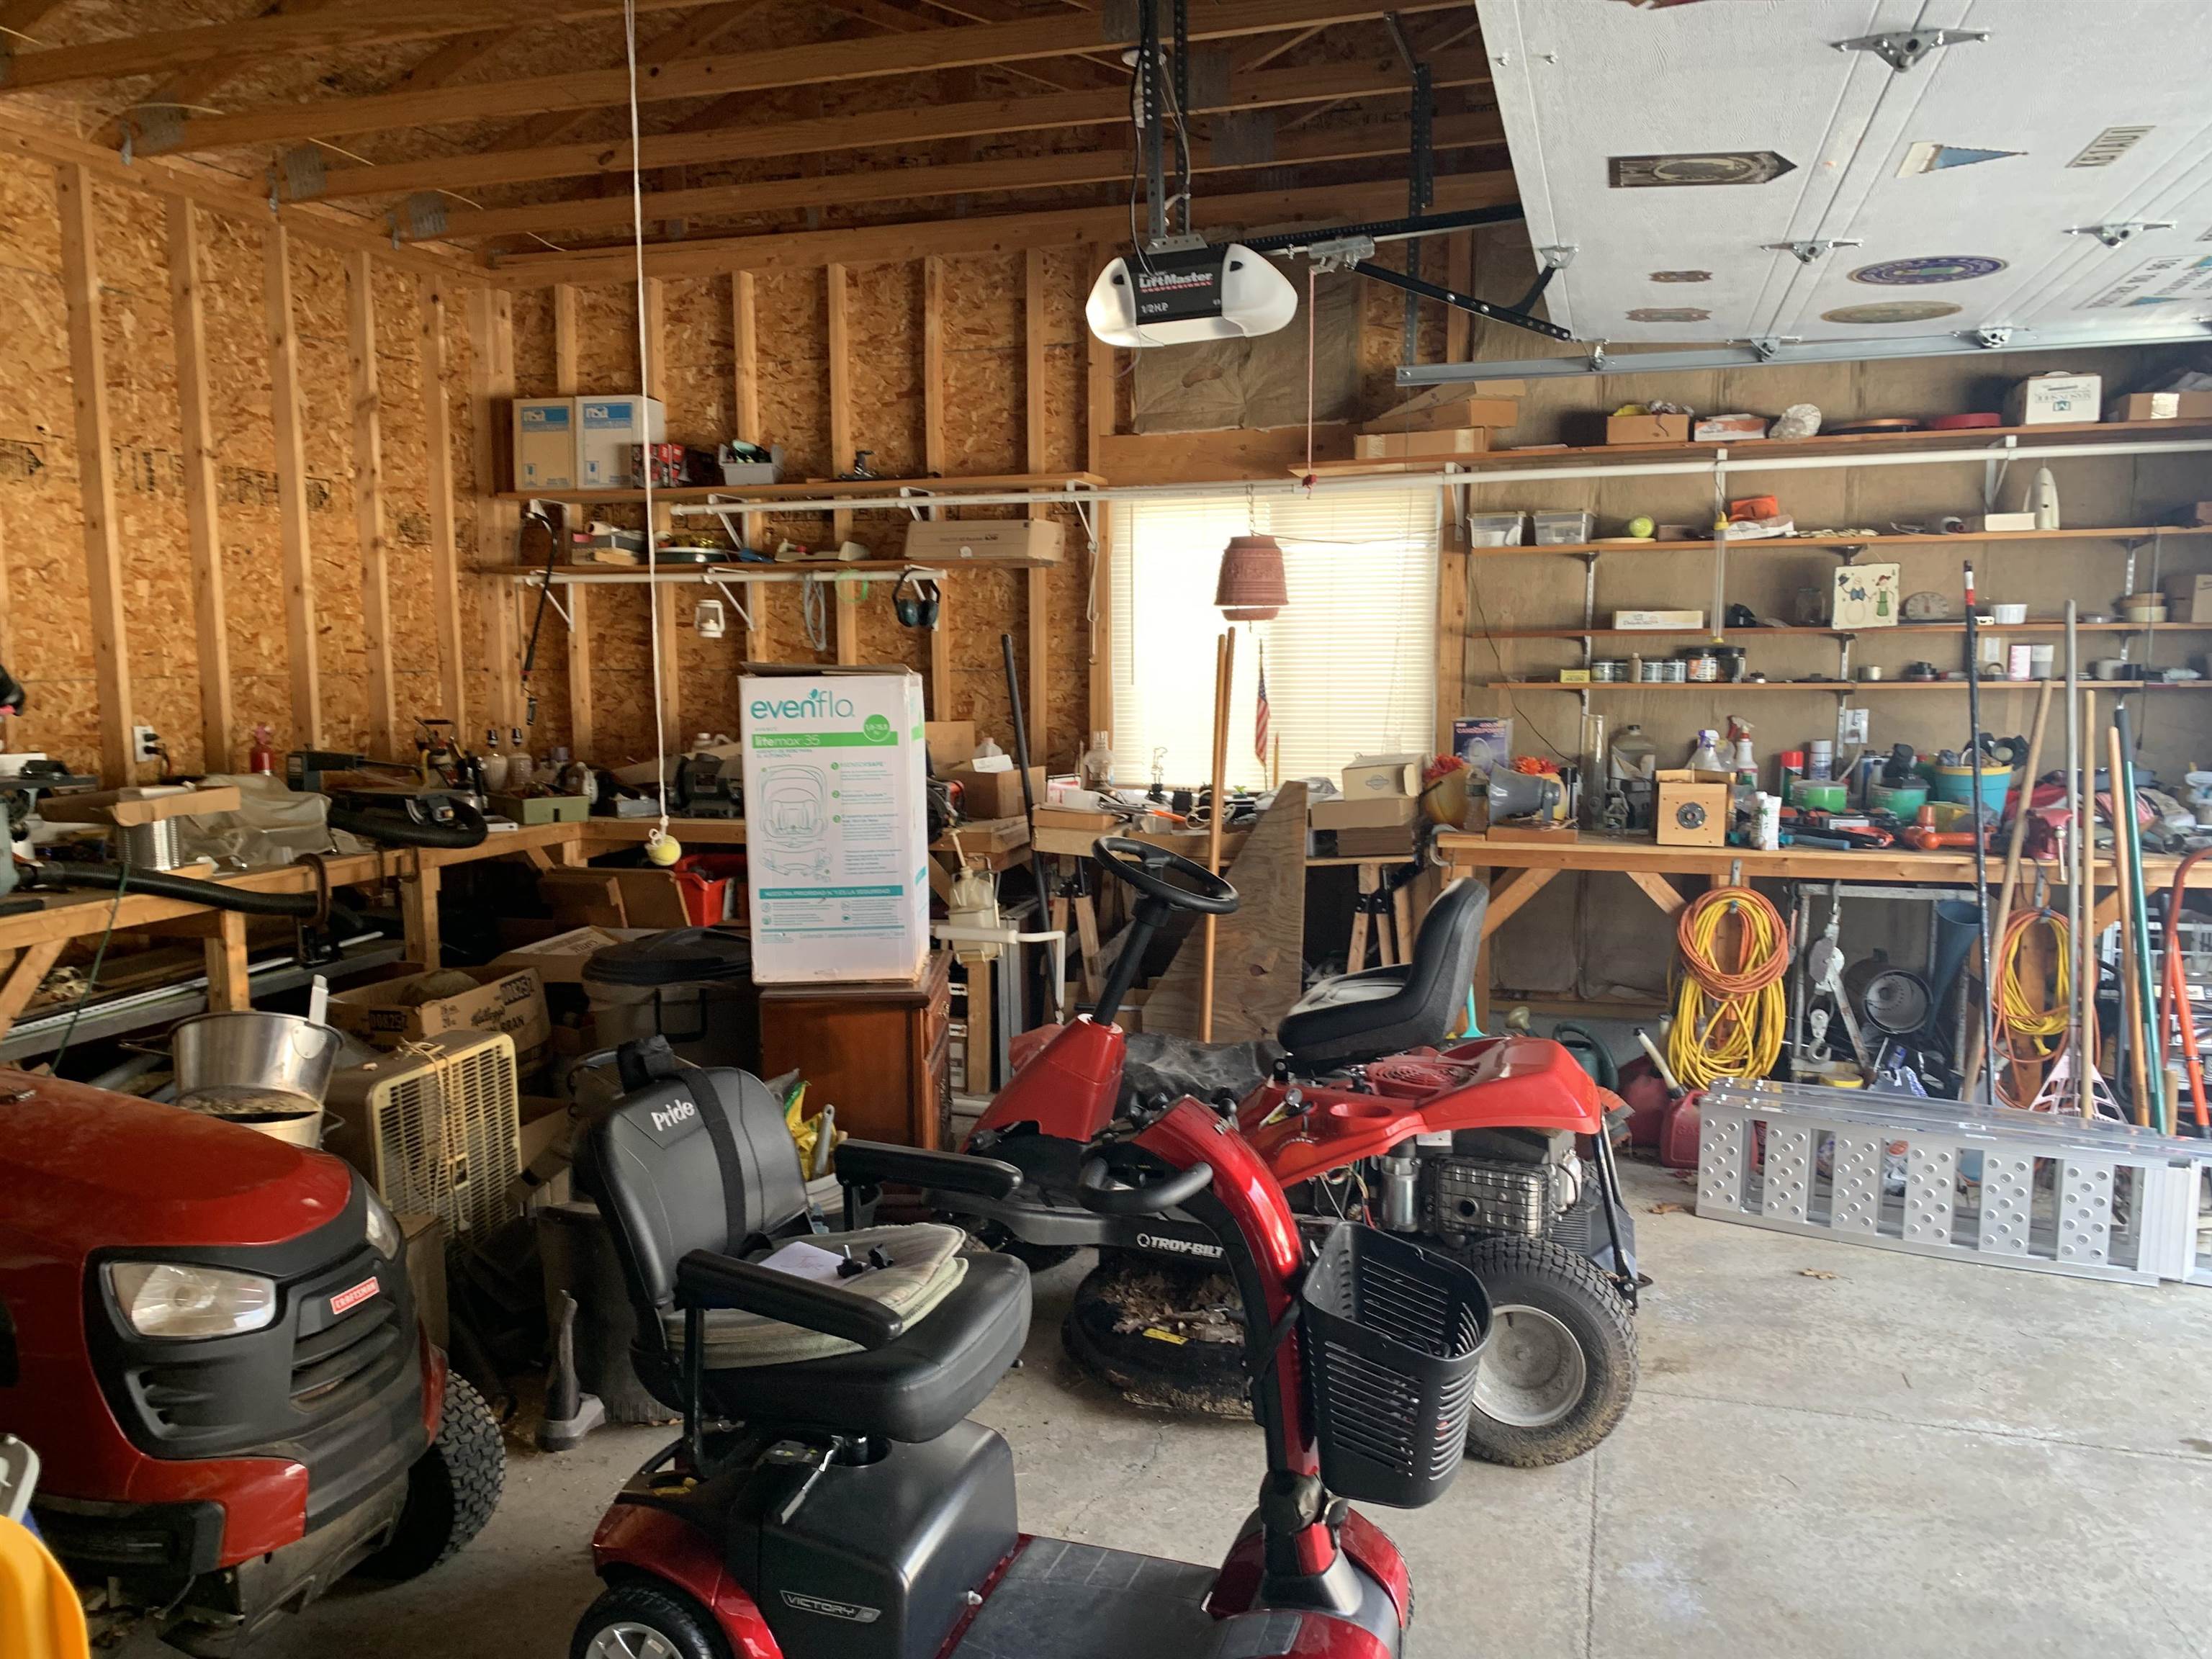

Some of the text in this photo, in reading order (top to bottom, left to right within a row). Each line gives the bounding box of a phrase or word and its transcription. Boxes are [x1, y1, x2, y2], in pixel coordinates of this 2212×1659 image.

[1138, 271, 1214, 288] LiftMaster
[750, 688, 854, 719] evenflo
[804, 734, 821, 746] 35
[650, 1099, 696, 1132] Pride
[1151, 1236, 1224, 1259] TROY-BILT
[787, 1594, 855, 1616] VICTORY
